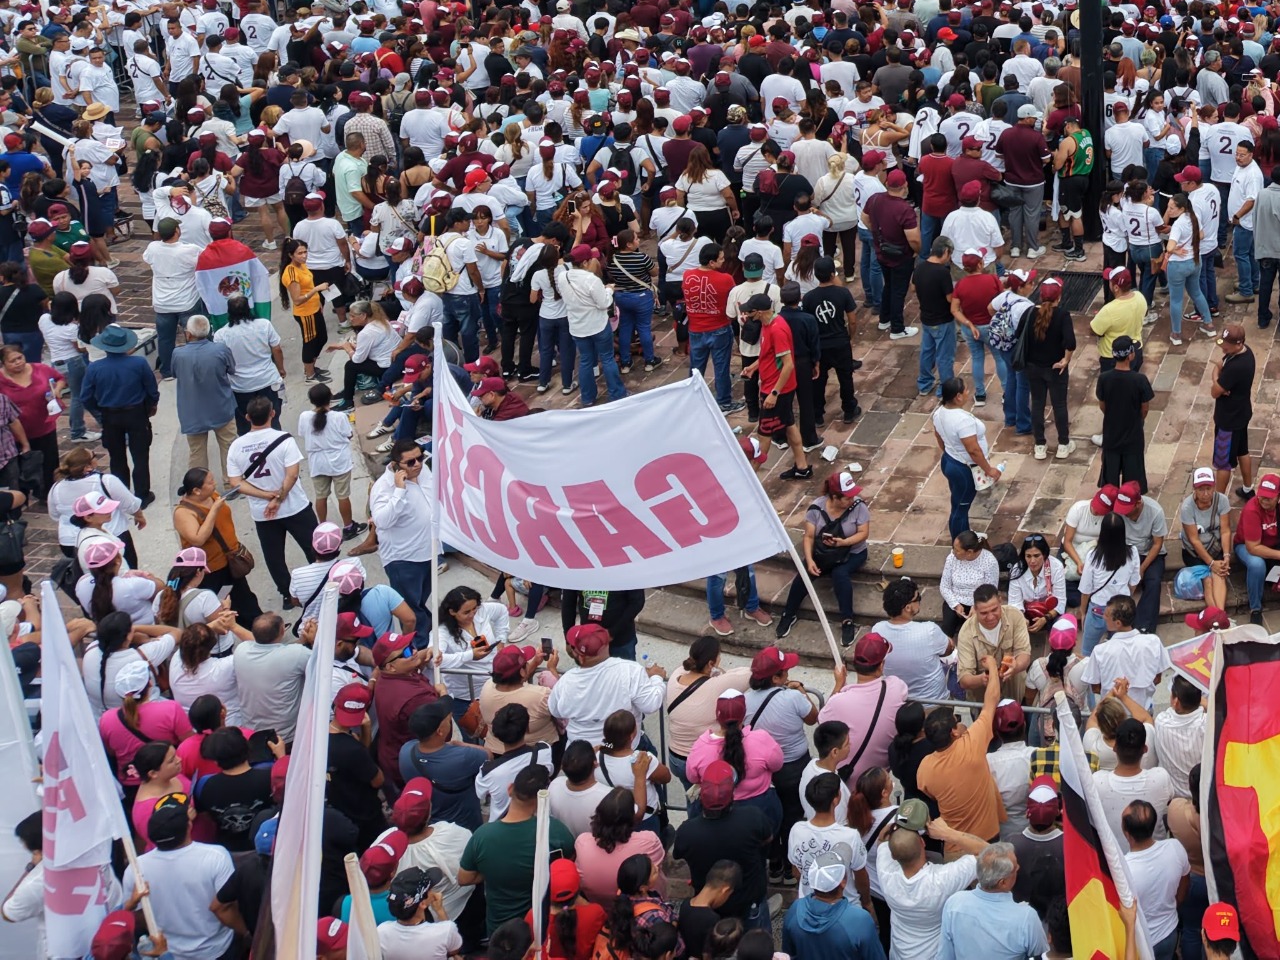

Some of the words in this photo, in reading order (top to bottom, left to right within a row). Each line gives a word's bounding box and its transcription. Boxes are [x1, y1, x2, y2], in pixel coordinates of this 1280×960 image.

[248, 26, 258, 39] 2
[1106, 104, 1113, 118] 6
[1219, 136, 1232, 154] 2
[1085, 146, 1093, 165] 3
[1210, 199, 1218, 220] 2
[1129, 218, 1141, 237] 2
[249, 452, 271, 478] 2
[1220, 918, 1230, 926] PT
